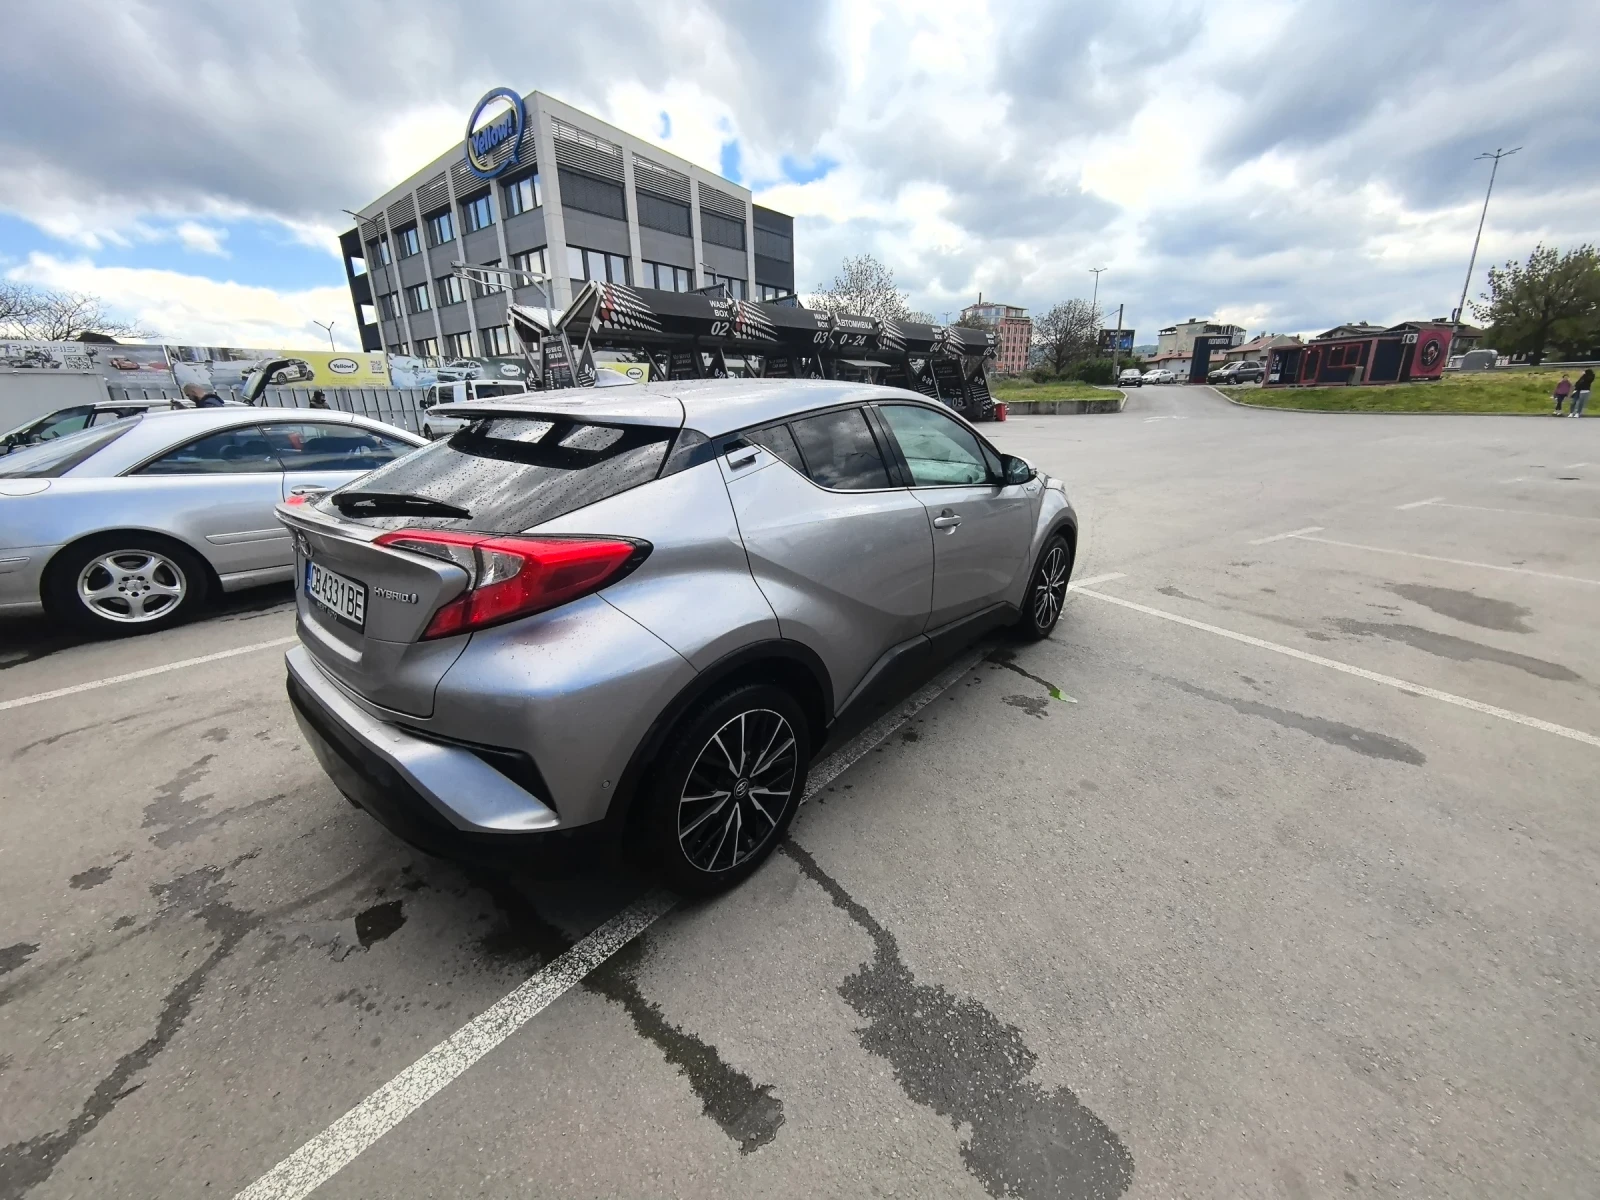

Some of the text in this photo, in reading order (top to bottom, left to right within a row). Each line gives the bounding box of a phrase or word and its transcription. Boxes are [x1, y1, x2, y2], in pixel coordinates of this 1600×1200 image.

[472, 112, 513, 157] Yellow!
[708, 299, 730, 309] WASH
[713, 309, 729, 318] BOX
[813, 313, 829, 321] WASH
[710, 321, 730, 336] 02
[837, 319, 874, 330] АВТОМИВКА
[813, 331, 829, 344] 03
[929, 342, 943, 352] 04
[952, 397, 964, 408] 05
[374, 586, 409, 602] HYBRID
